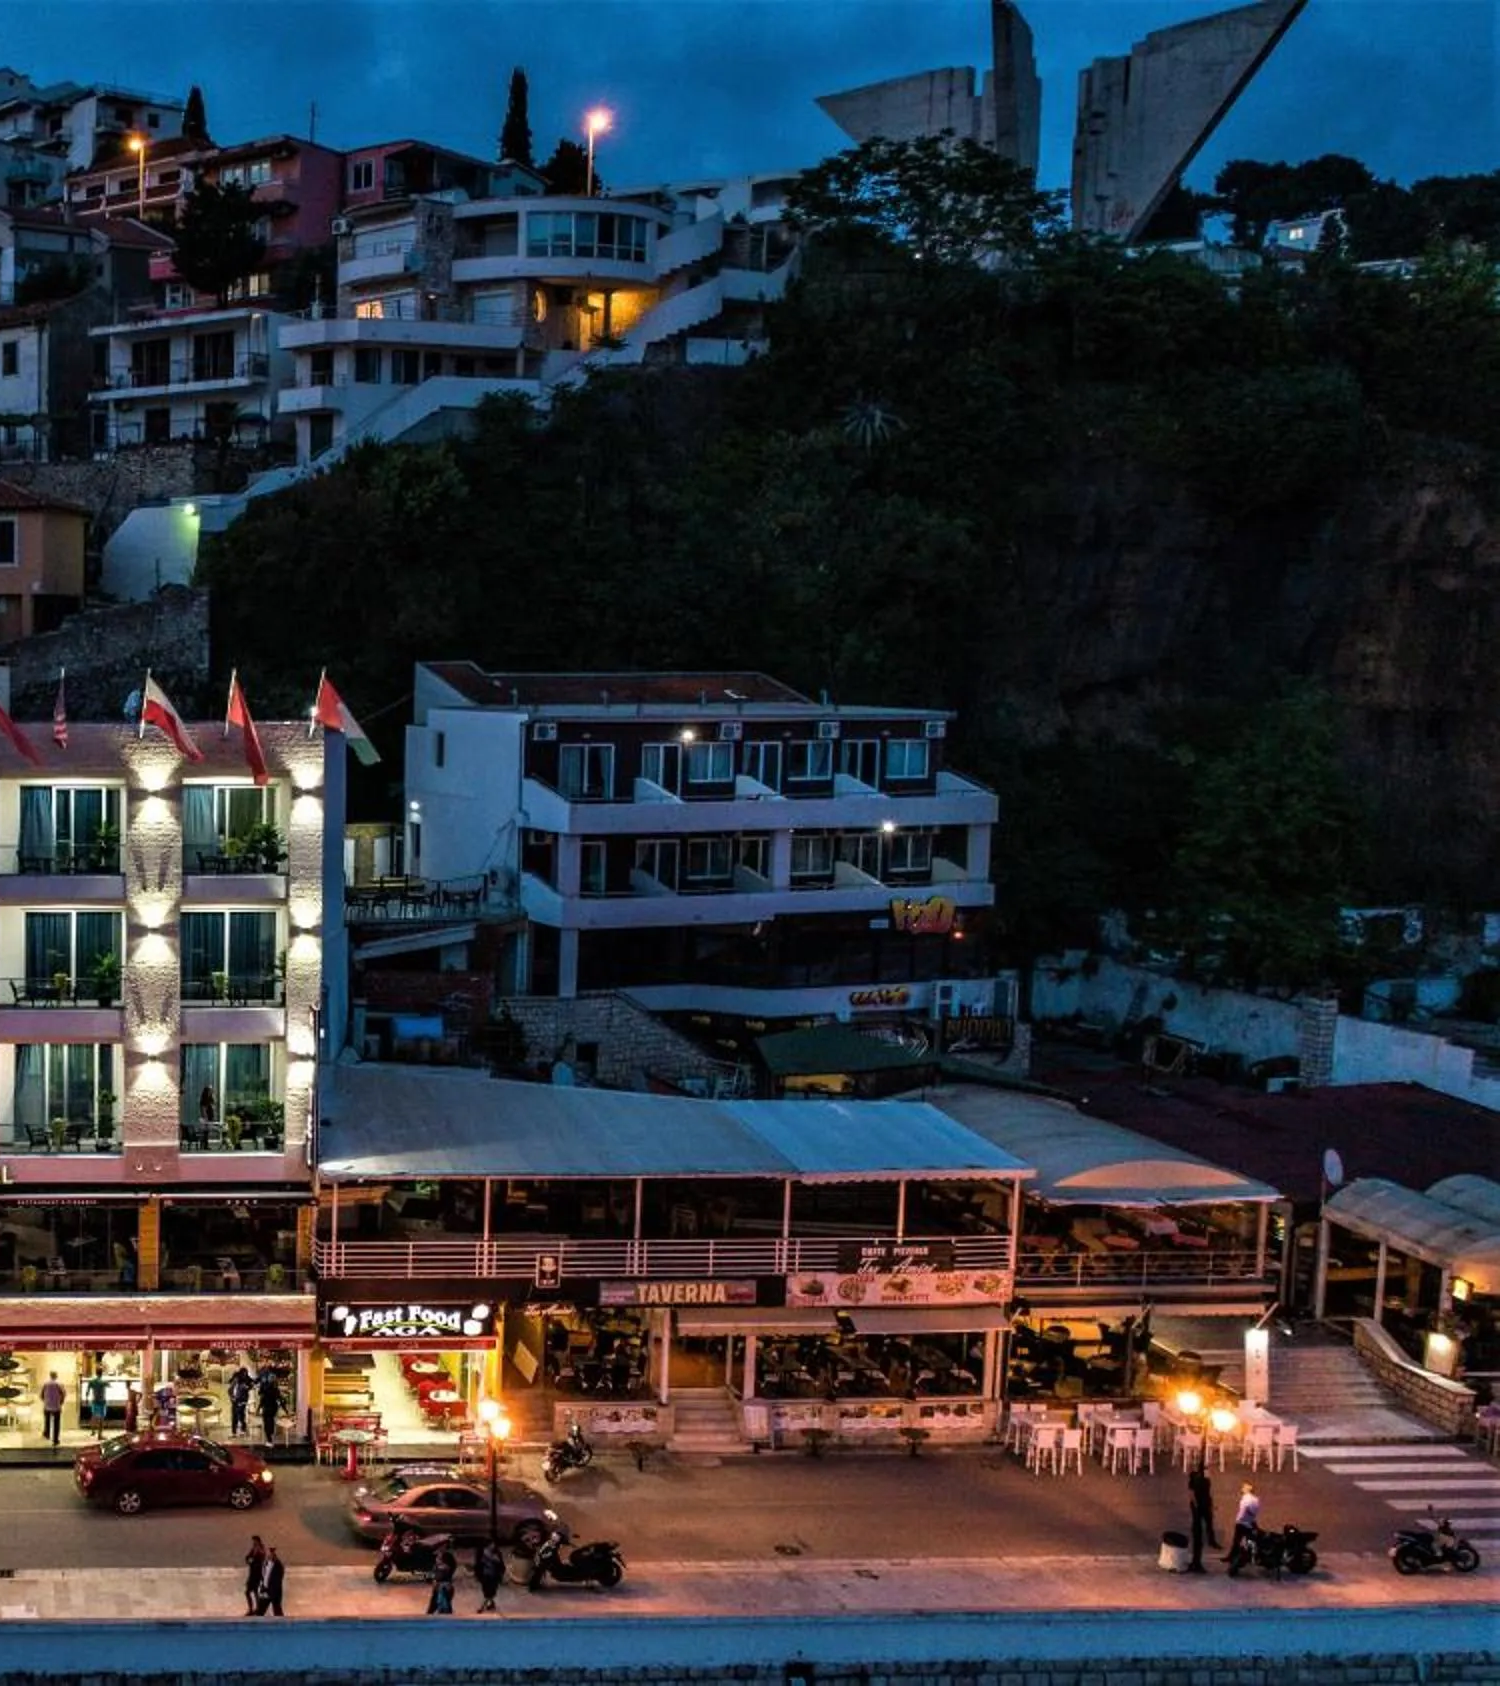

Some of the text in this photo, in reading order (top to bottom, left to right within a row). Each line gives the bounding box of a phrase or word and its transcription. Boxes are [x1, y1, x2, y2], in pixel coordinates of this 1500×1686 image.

[637, 1283, 726, 1304] TAVERNA
[360, 1305, 461, 1329] Fast Food
